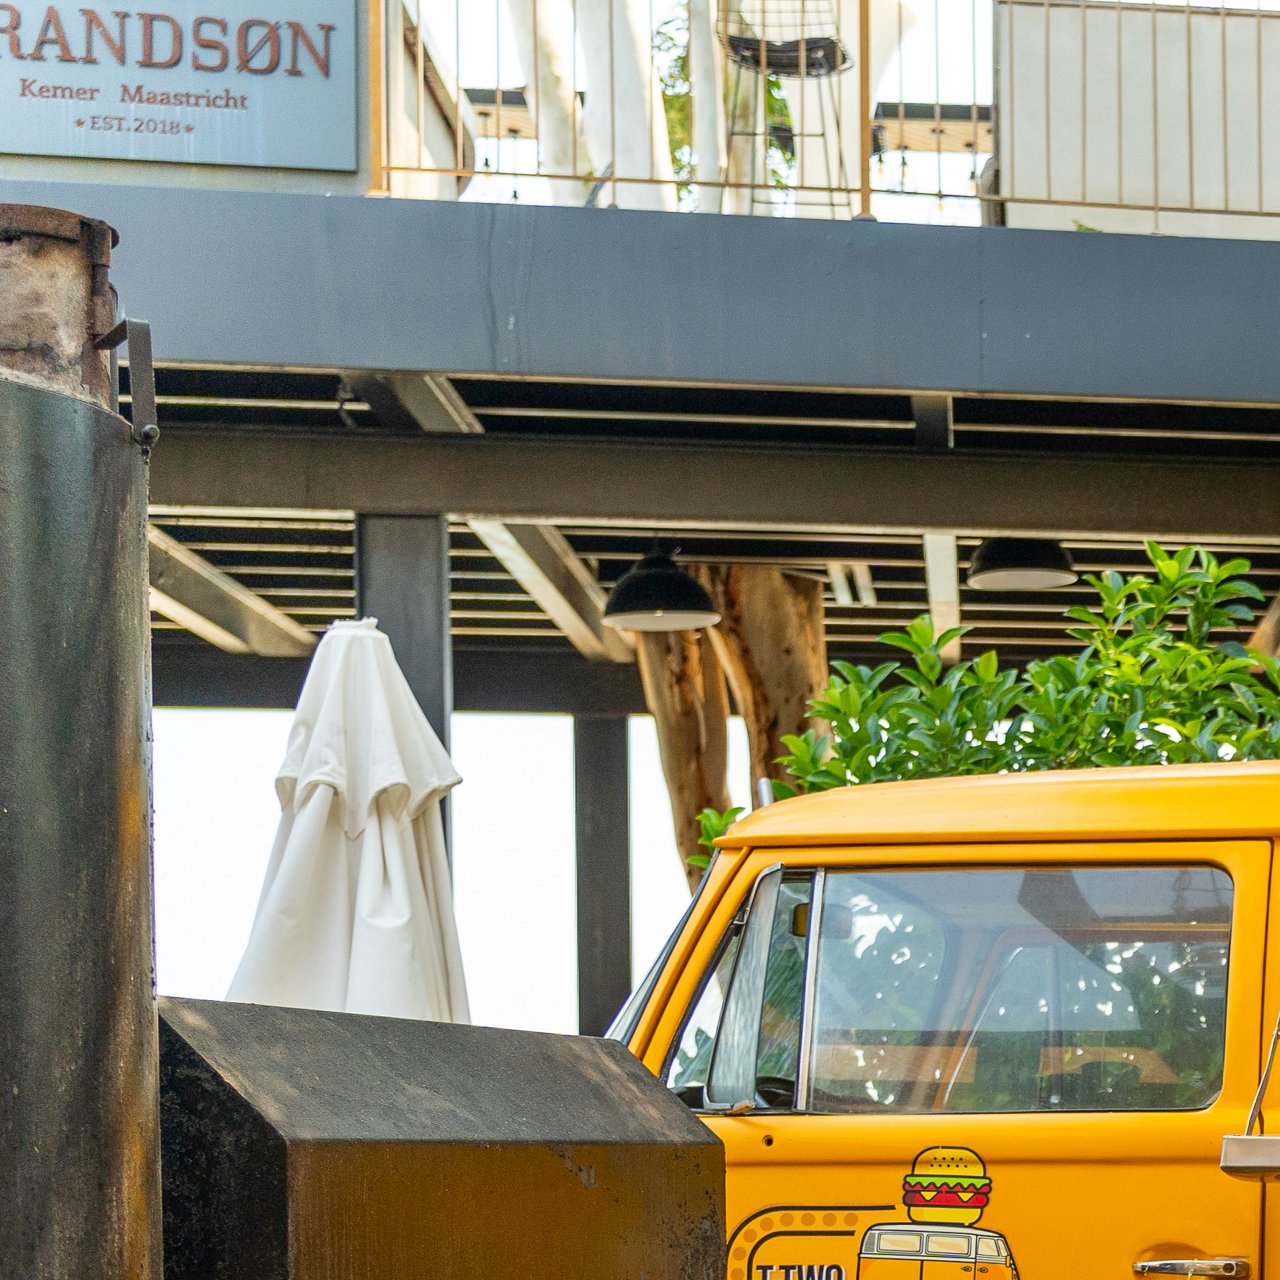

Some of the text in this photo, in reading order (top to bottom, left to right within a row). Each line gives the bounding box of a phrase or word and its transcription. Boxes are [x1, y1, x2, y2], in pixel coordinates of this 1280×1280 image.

[19, 77, 249, 110] Kemer Maastricht
[90, 116, 182, 136] EST.2018
